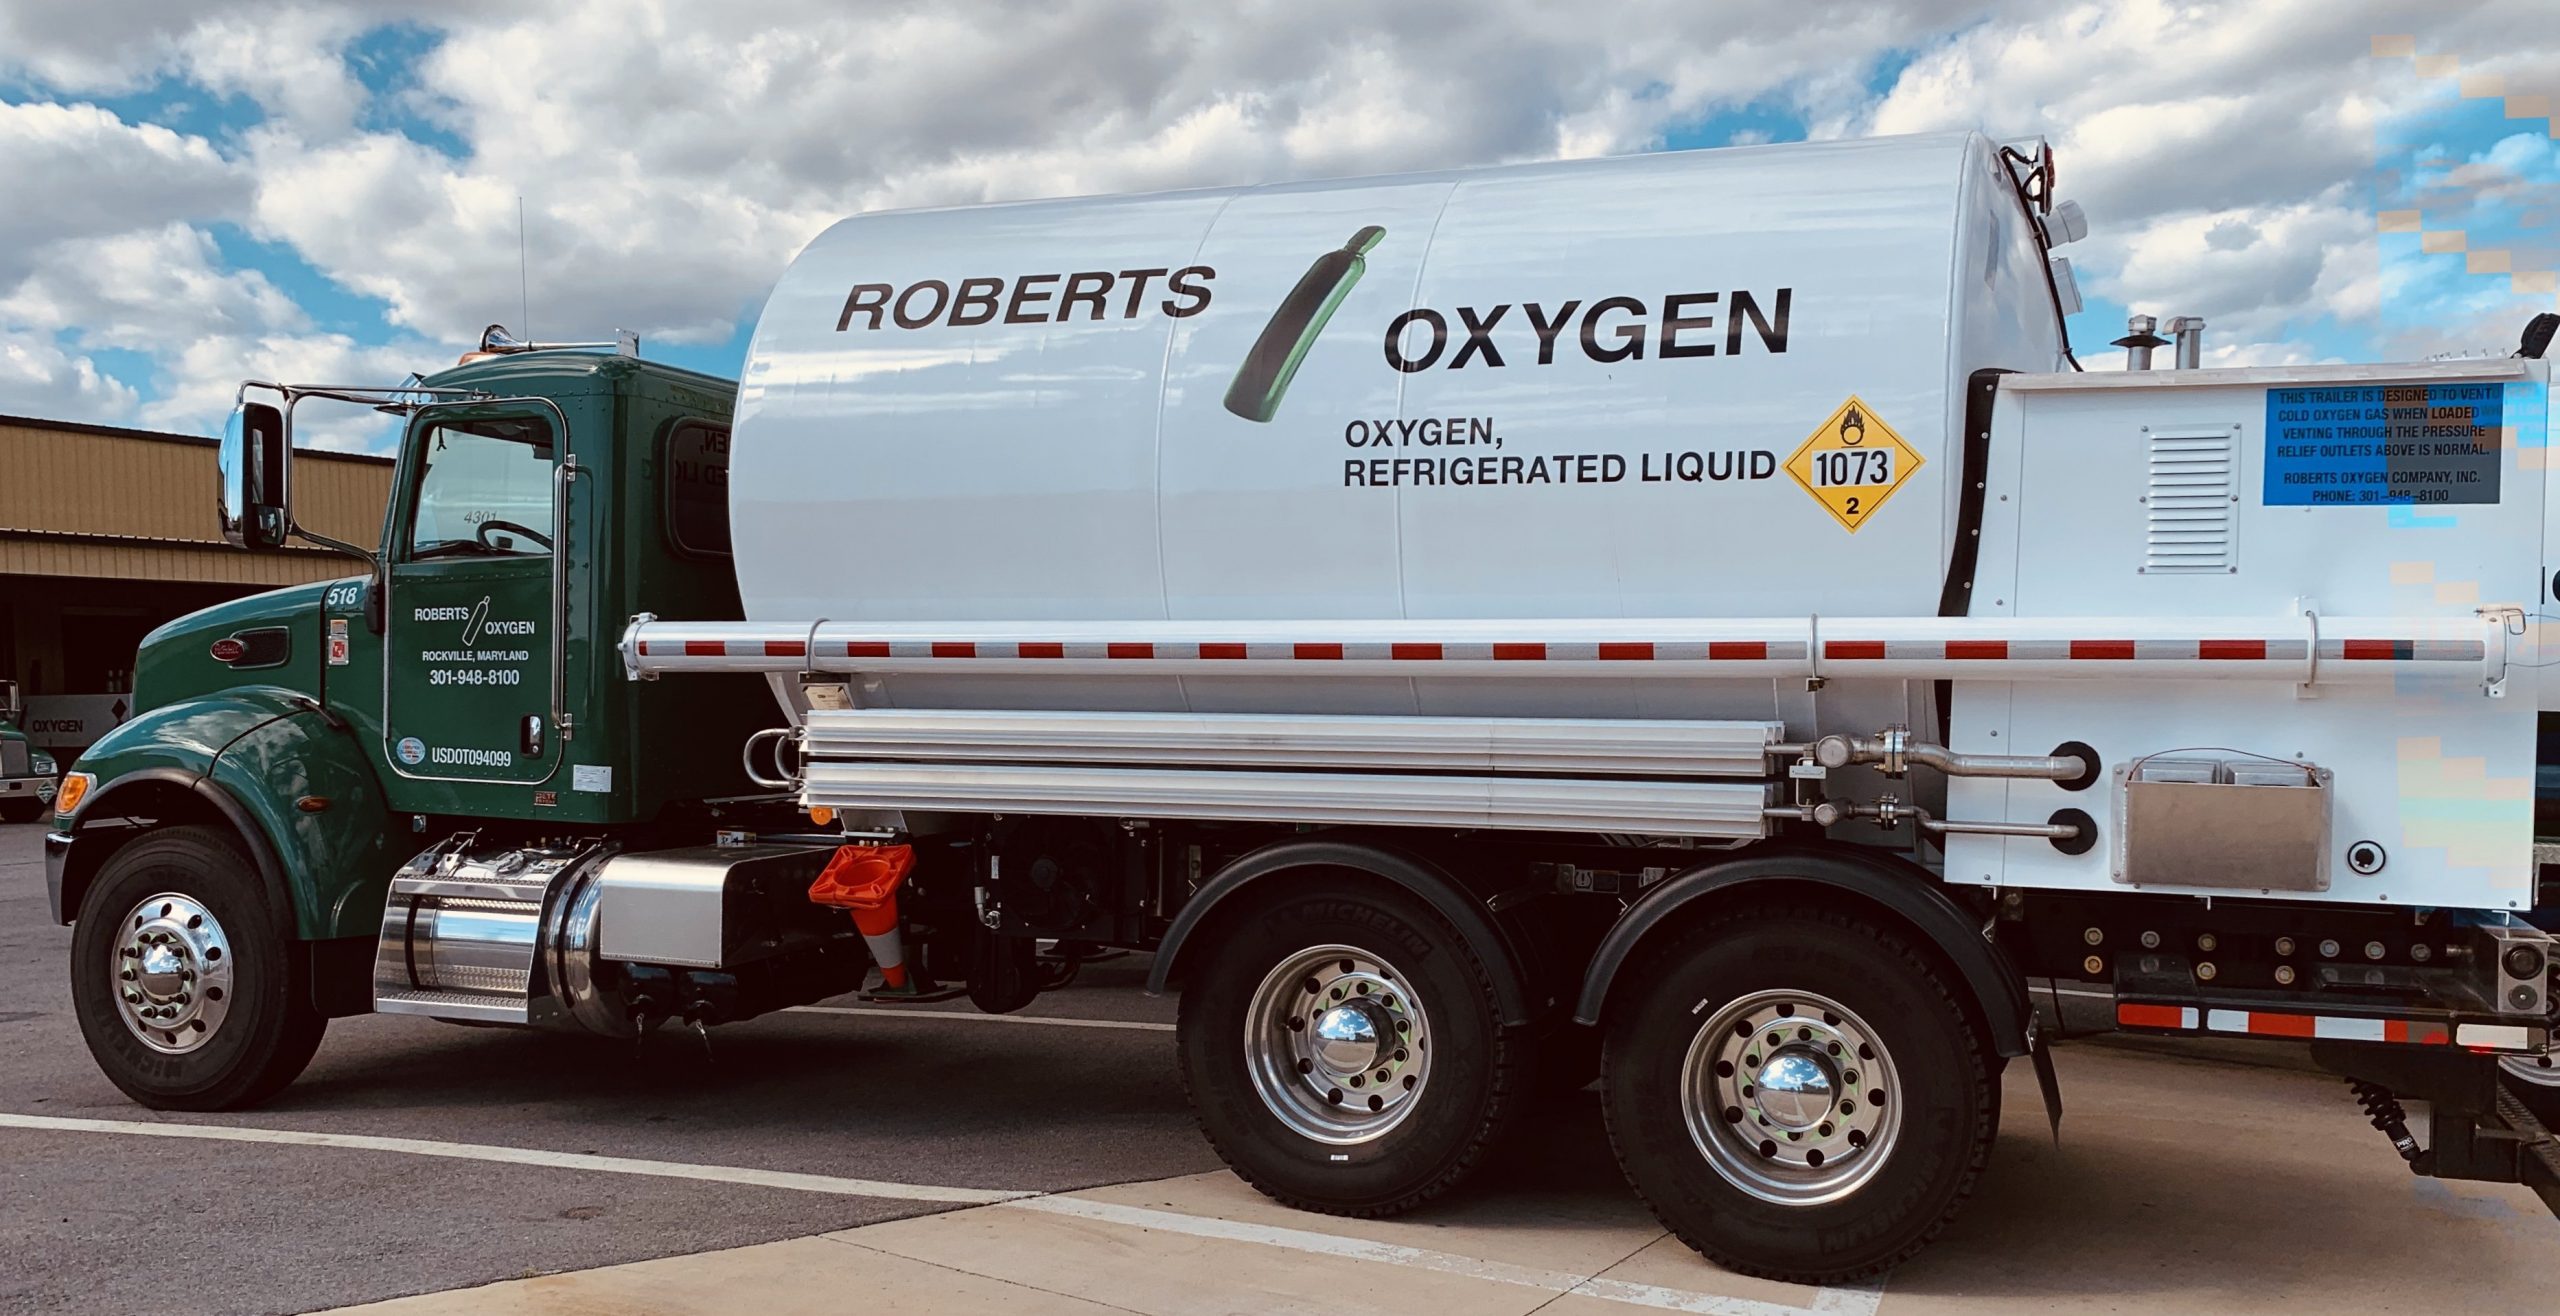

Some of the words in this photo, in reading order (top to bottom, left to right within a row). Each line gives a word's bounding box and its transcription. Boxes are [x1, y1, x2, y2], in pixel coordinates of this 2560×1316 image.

[837, 265, 1215, 332] ROBERTS
[1385, 287, 1792, 373] OXYGEN
[2280, 392, 2305, 404] THIS
[2310, 390, 2358, 403] TRAILER
[2363, 390, 2374, 402] IS
[2378, 389, 2437, 402] DESIGNED
[2442, 389, 2457, 400] TO
[2461, 388, 2492, 400] VENT
[2279, 409, 2309, 422] COLD
[2314, 409, 2360, 421] OXYGEN
[2365, 408, 2389, 420] GAS
[2392, 407, 2428, 420] WHEN
[2431, 406, 2480, 419] LOADED
[1345, 417, 1503, 450] OXYGEN,
[2283, 427, 2333, 439] VENTING
[2336, 426, 2392, 439] THROUGH
[2396, 425, 2419, 438] THE
[2422, 425, 2486, 437] PRESSURE
[2278, 445, 2317, 458] RELIEF
[2321, 444, 2372, 457] OUTLETS
[2376, 444, 2415, 456] ABOVE
[2419, 444, 2431, 456] IS
[2434, 443, 2490, 456] NORMAL.
[1344, 455, 1626, 487] REFRIGERATED
[1642, 450, 1776, 483] LIQUID
[1816, 450, 1888, 486] 1073
[2284, 472, 2338, 485] ROBERTS
[2341, 472, 2389, 484] OXYGEN
[2392, 471, 2453, 485] COMPANY,
[2456, 470, 2480, 483] INC.
[2313, 490, 2356, 502] PHONE:
[1846, 497, 1859, 515] 2
[328, 587, 358, 605] 518
[414, 607, 470, 622] ROBERTS
[485, 621, 535, 635] OXYGEN
[422, 650, 476, 663] ROCKVILLE,
[477, 650, 529, 661] MARYLAND
[430, 669, 520, 685] 301-948-8100
[32, 719, 84, 733] OXYGEN
[432, 747, 512, 767] USDOT094099
[1303, 903, 1431, 957] MICHELIN
